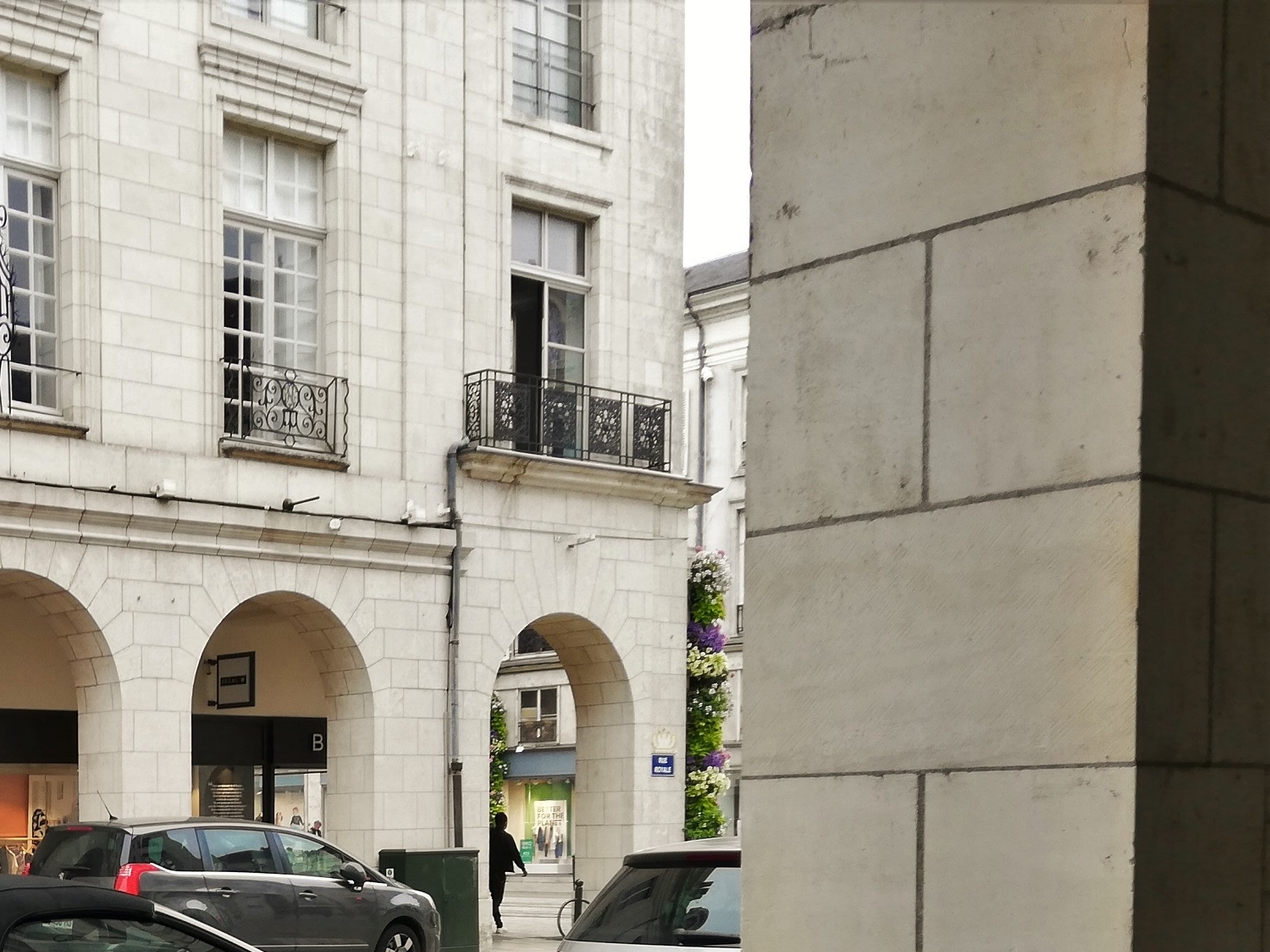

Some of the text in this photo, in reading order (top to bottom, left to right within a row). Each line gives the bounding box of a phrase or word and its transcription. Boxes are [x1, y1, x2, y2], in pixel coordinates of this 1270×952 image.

[313, 733, 324, 751] B
[537, 805, 561, 813] BETTER
[537, 812, 551, 820] FOR
